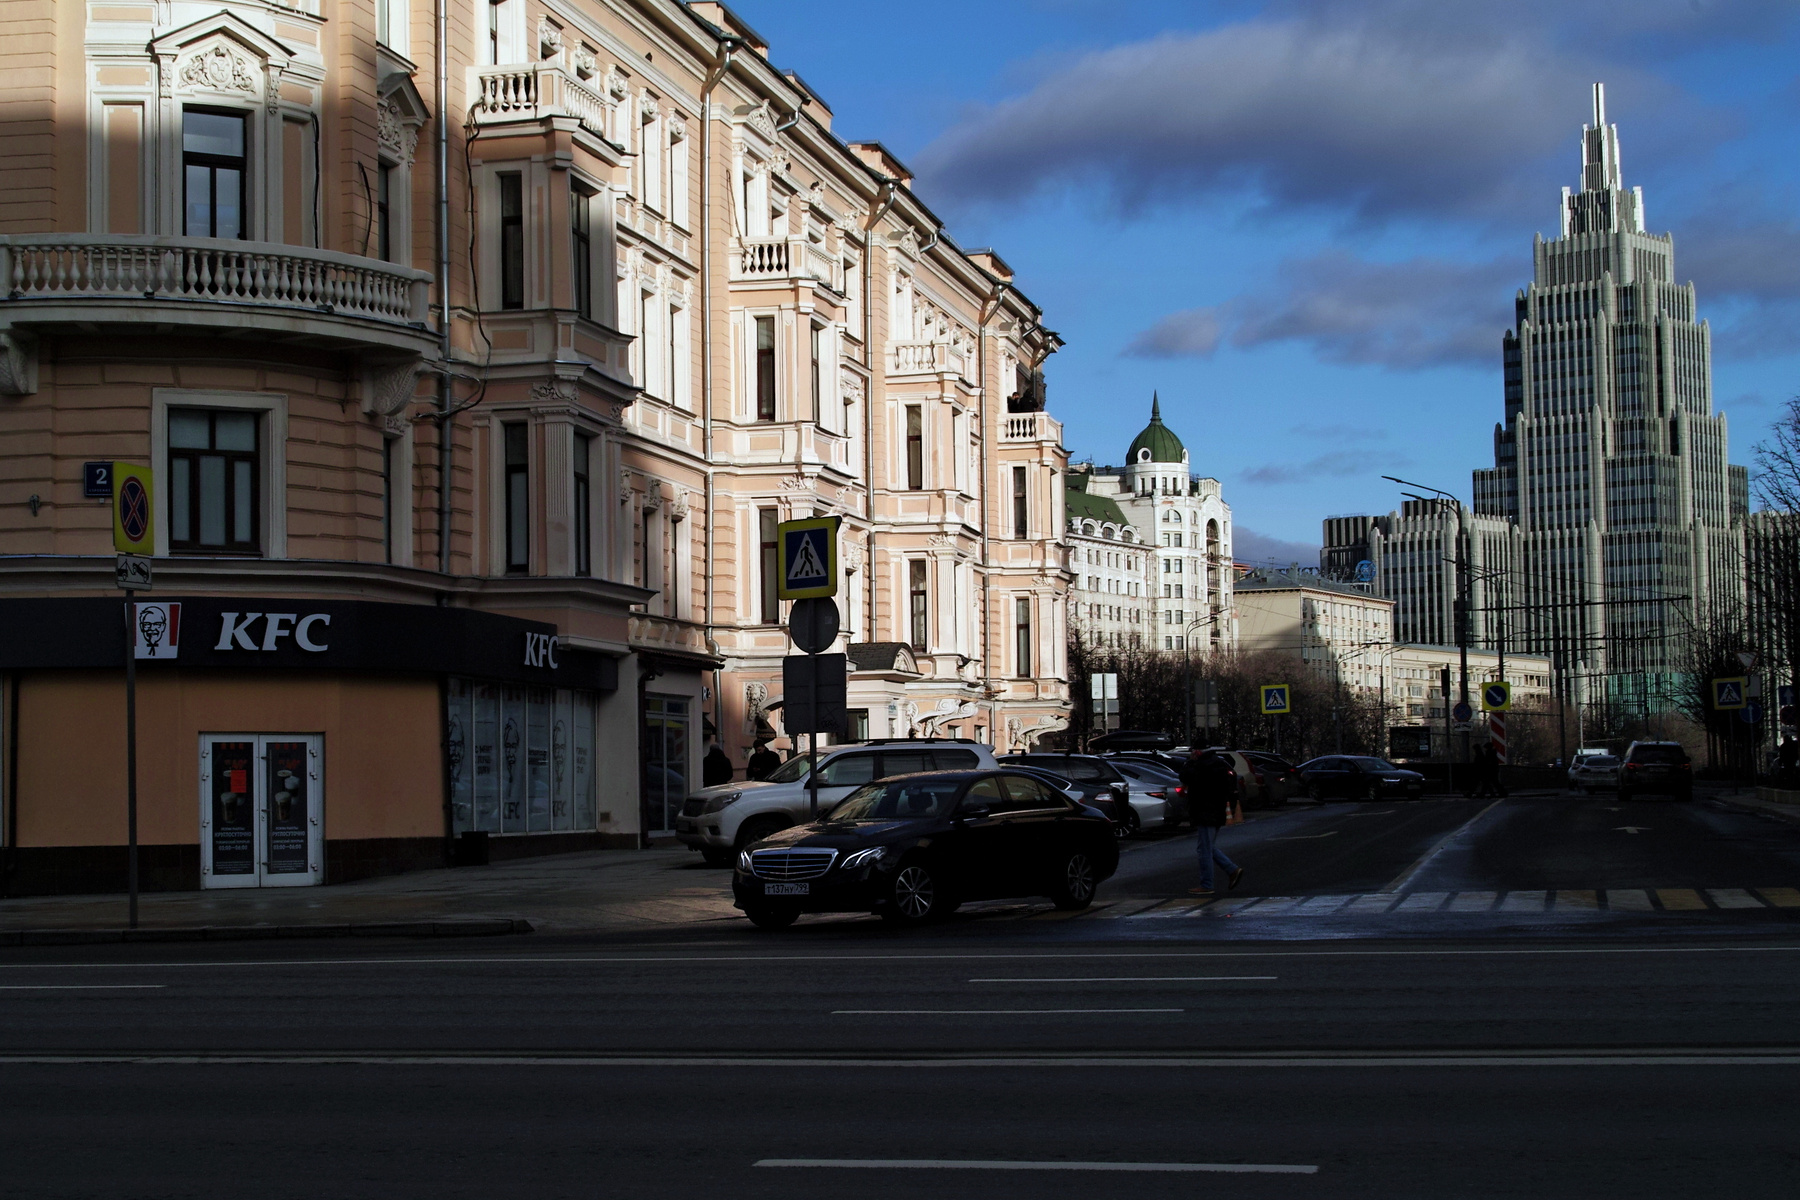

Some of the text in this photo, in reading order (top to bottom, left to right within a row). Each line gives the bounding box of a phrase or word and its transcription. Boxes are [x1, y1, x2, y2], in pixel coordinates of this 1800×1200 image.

[96, 468, 108, 485] 2
[214, 611, 331, 652] KFC
[523, 631, 559, 670] KFC
